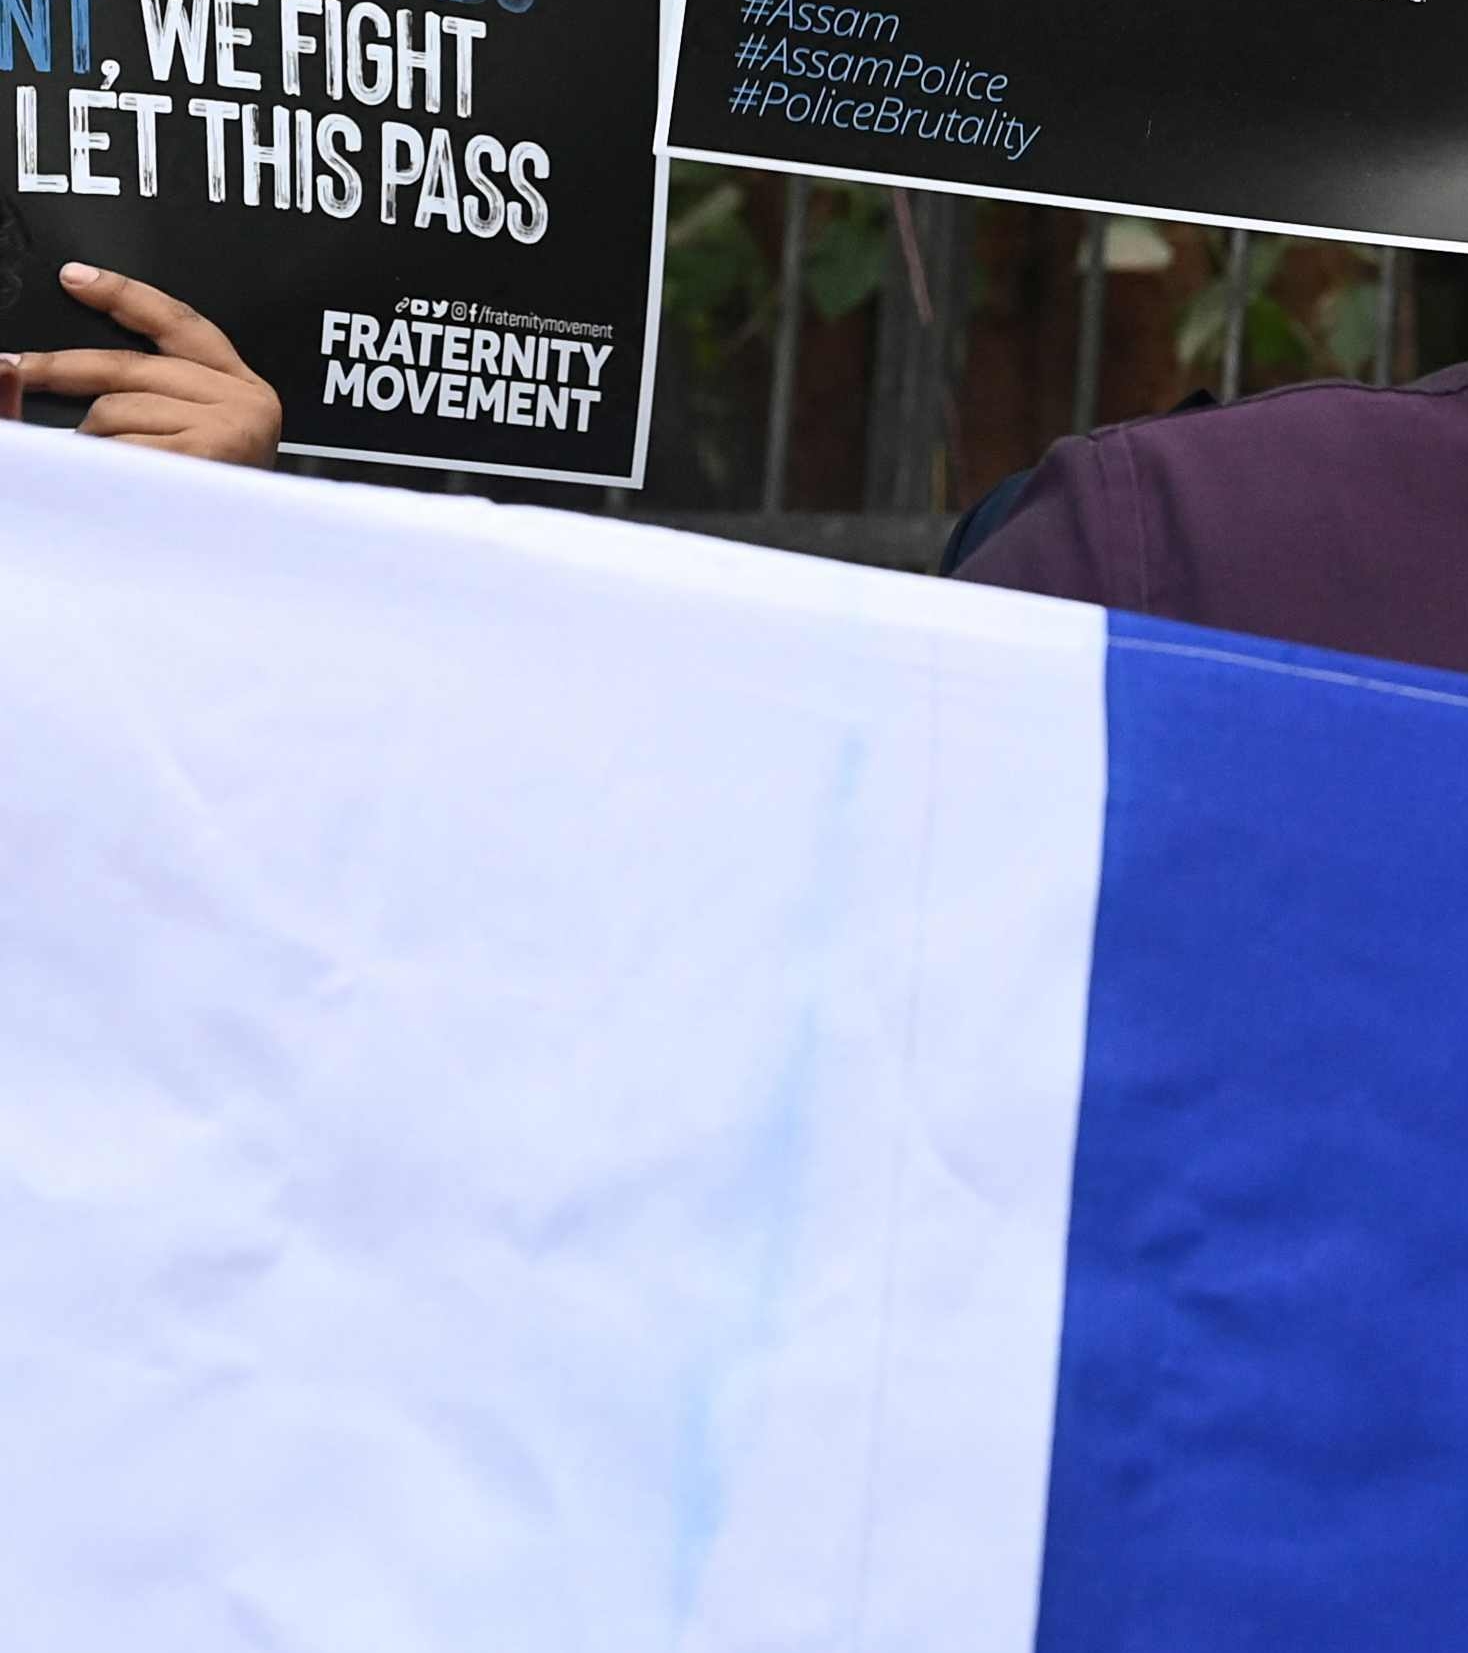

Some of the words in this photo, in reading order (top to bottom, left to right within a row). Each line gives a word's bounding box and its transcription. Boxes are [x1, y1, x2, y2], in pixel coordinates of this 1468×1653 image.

[734, 32, 1009, 103] #AssamPolice
[728, 77, 1041, 161] #PoliceBrutality
[16, 85, 173, 199] LET
[188, 100, 362, 219] THIS
[380, 121, 551, 245] PASS
[320, 309, 614, 387] FRATERNITY
[322, 359, 602, 433] MOVEMENT
